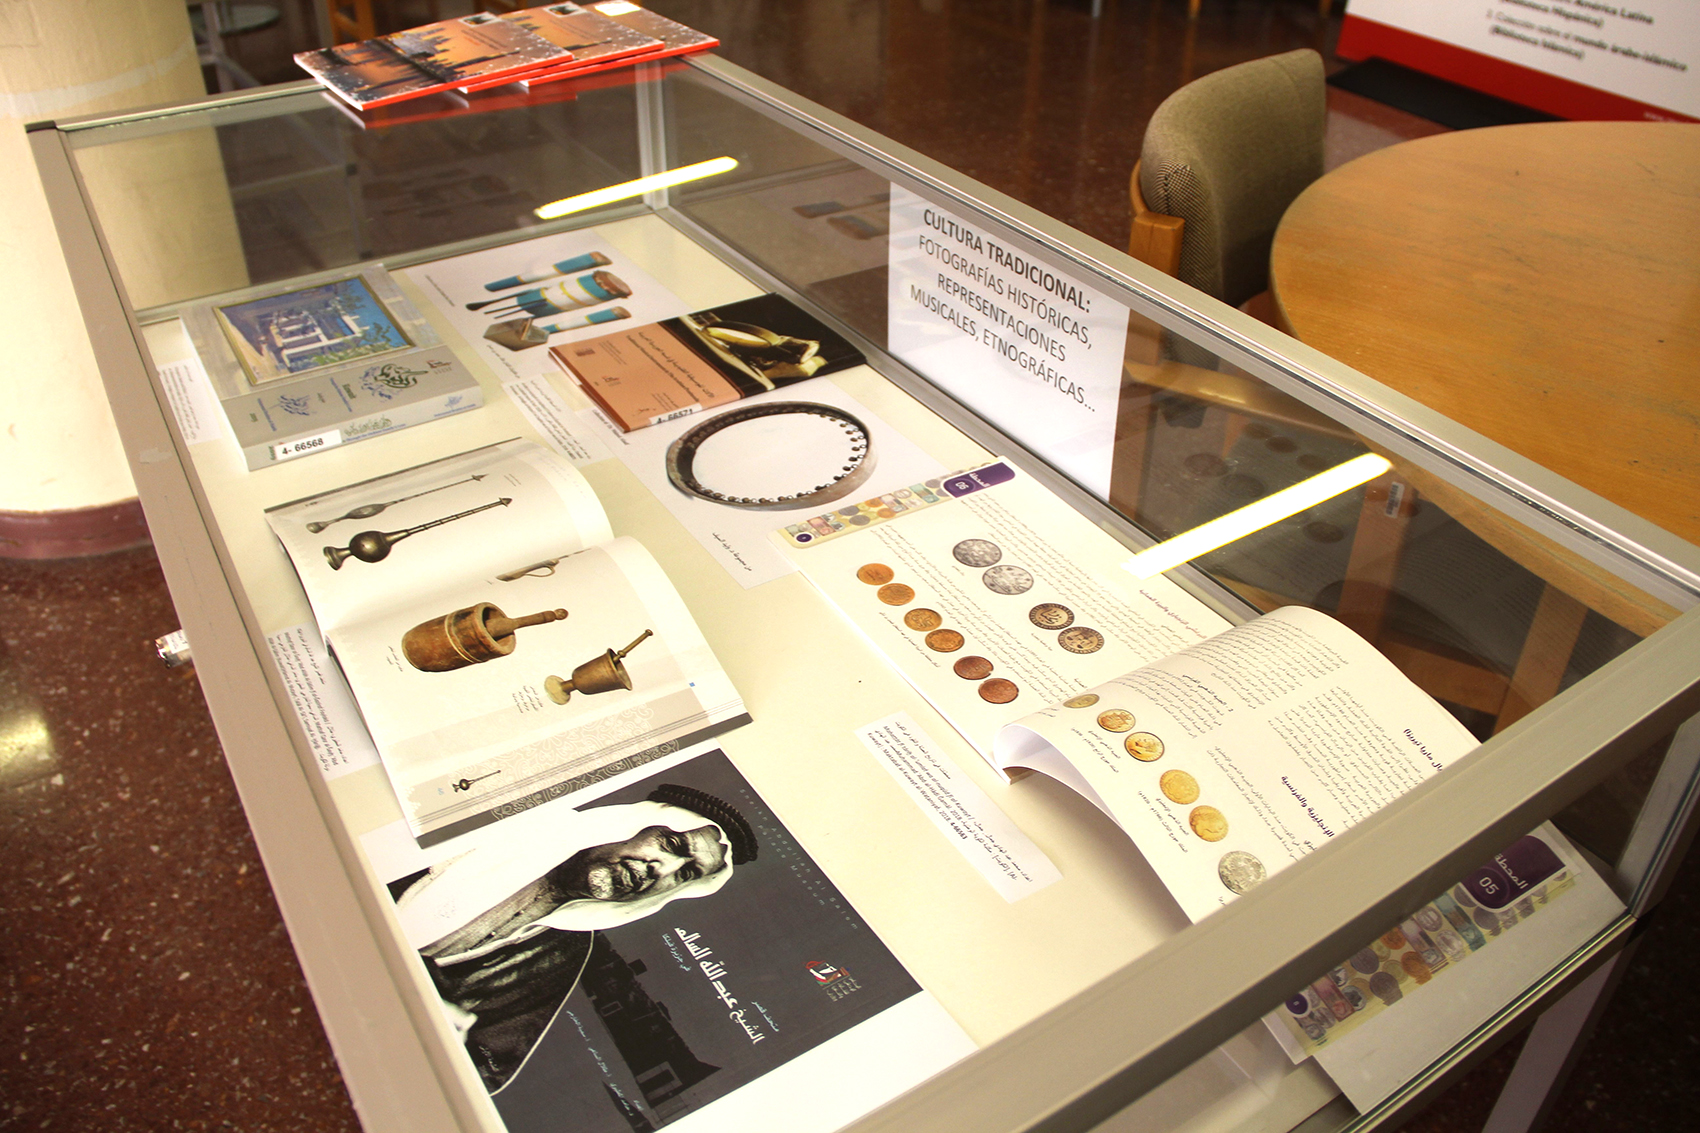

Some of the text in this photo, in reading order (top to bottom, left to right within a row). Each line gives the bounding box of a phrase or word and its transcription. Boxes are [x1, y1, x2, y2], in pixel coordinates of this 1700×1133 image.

[924, 208, 1091, 313] CULTURA TRADICIONAL:
[919, 235, 1093, 350] FOTOGRAFÍAS HISTÓRICAS,
[938, 273, 1066, 362] REPRESENTACIONES
[910, 284, 1095, 412] MUSICALES, ETNOGRÁFICAS...
[282, 447, 292, 456] 4-
[295, 438, 324, 452] 66568
[1420, 745, 1433, 760] ماريا
[1281, 776, 1307, 807] والفرنسية
[1307, 807, 1334, 837] الإنجليزية
[1478, 876, 1500, 895] 05
[1494, 853, 1529, 890] المحطة
[674, 927, 712, 960] السالم
[730, 1008, 765, 1045] الشيخ
